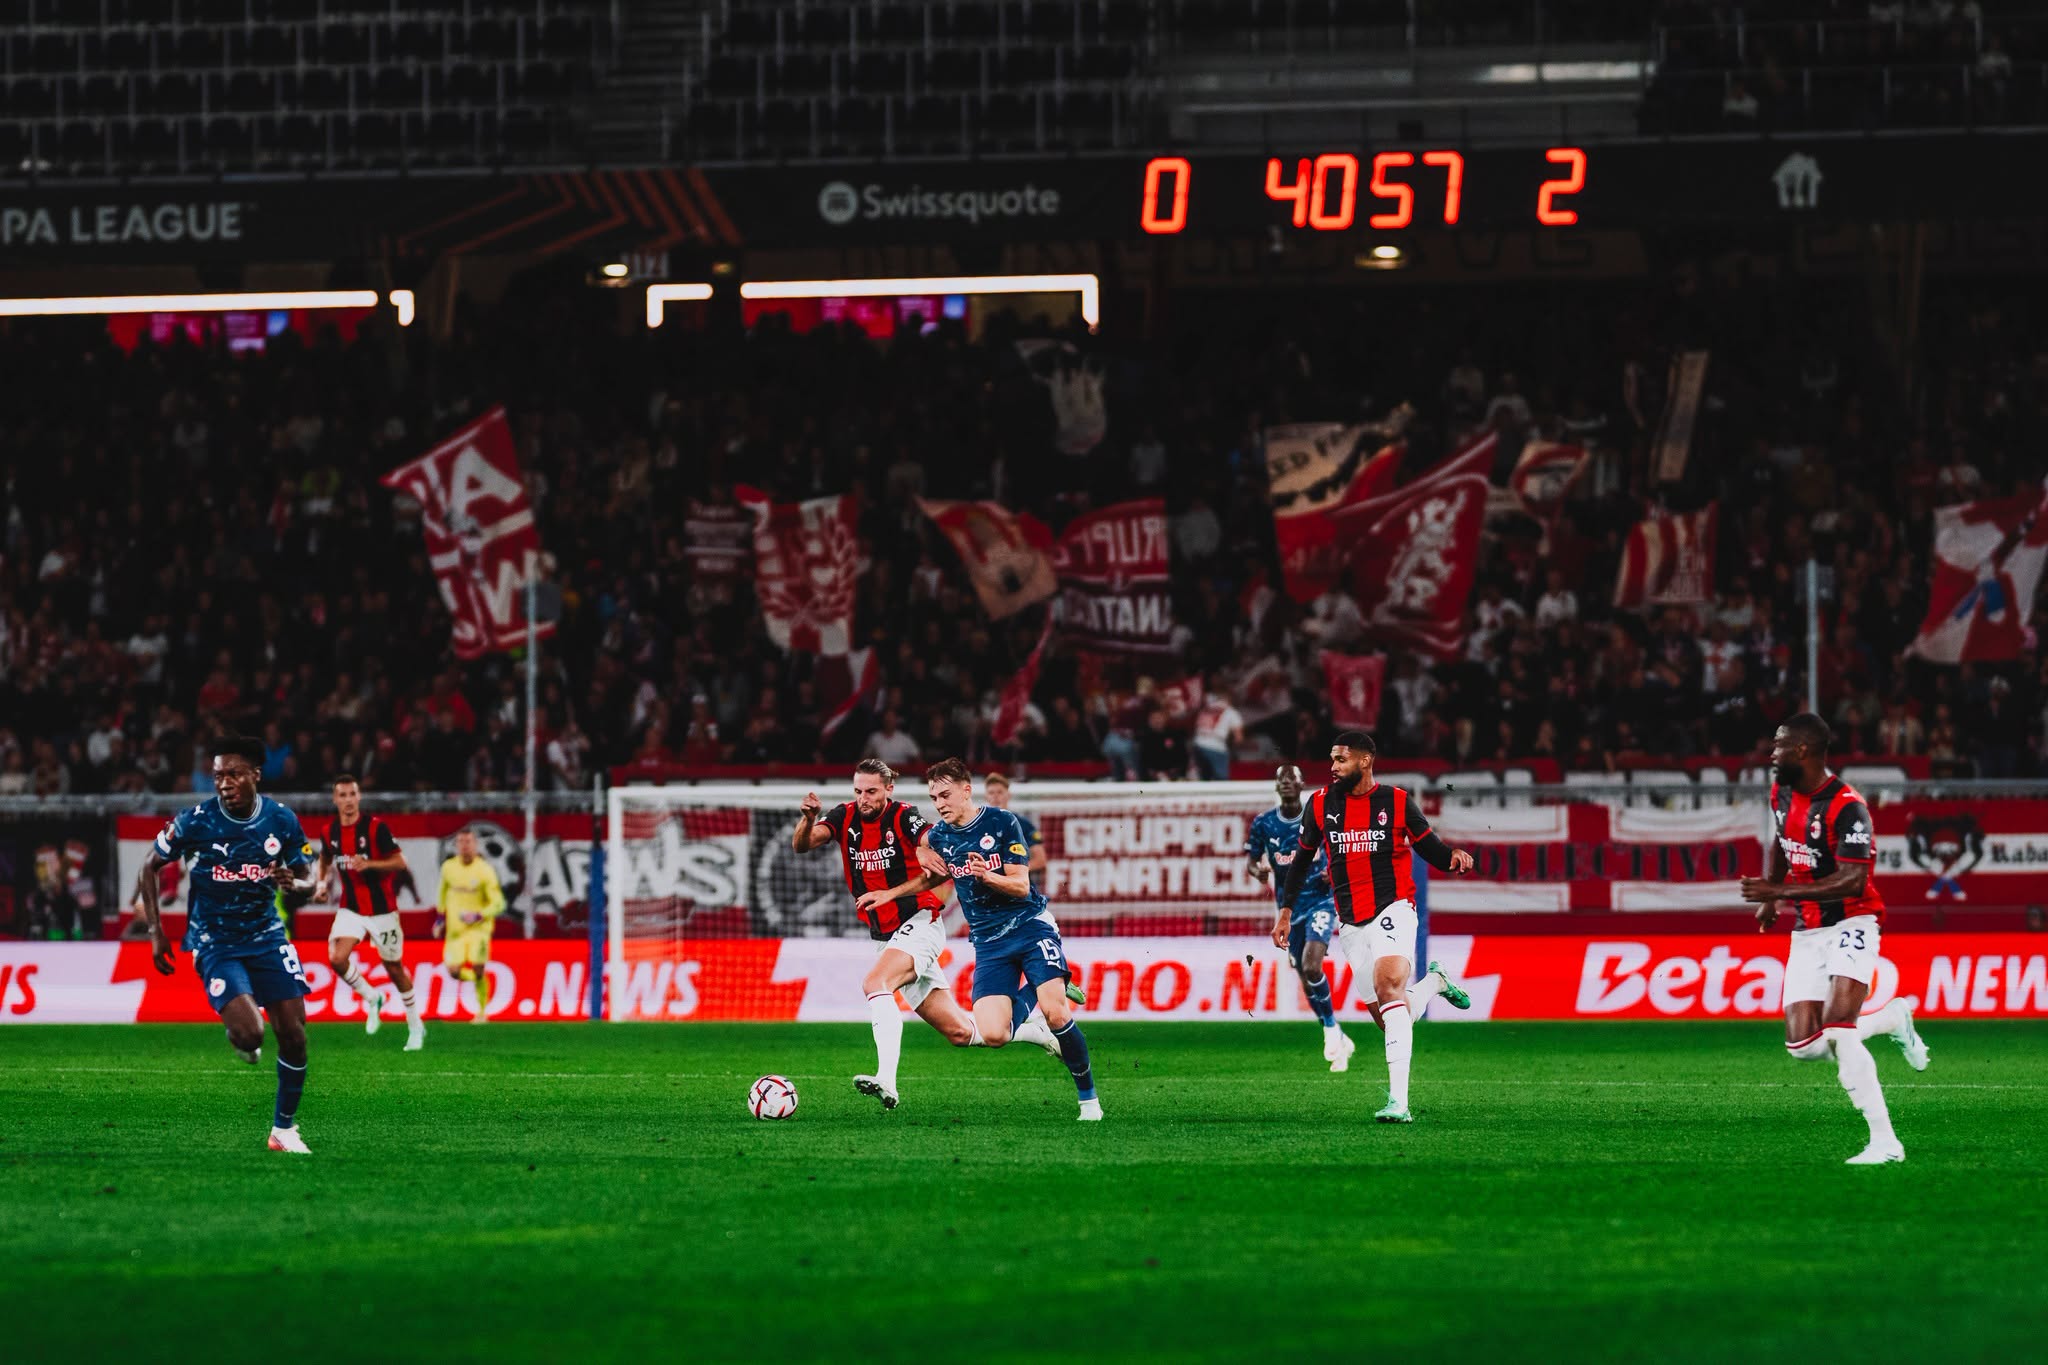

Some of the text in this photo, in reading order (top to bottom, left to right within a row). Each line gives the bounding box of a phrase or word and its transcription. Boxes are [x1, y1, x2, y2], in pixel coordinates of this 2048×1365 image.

[1140, 156, 1191, 234] 0
[1537, 147, 1587, 226] 2
[861, 183, 1061, 227] Swissquote
[70, 202, 242, 243] LEAGUE
[1063, 816, 1244, 857] GRUPPO
[1329, 829, 1386, 843] Emirates
[1844, 833, 1871, 845] MSC
[848, 846, 896, 861] Emirates
[1338, 841, 1378, 854] FLY BETTER
[866, 858, 891, 872] BETTER
[1473, 842, 1739, 882] OLLECTIVO
[1380, 916, 1395, 931] 8
[380, 929, 398, 945] 73
[1839, 929, 1865, 950] 23
[1036, 938, 1061, 960] 15
